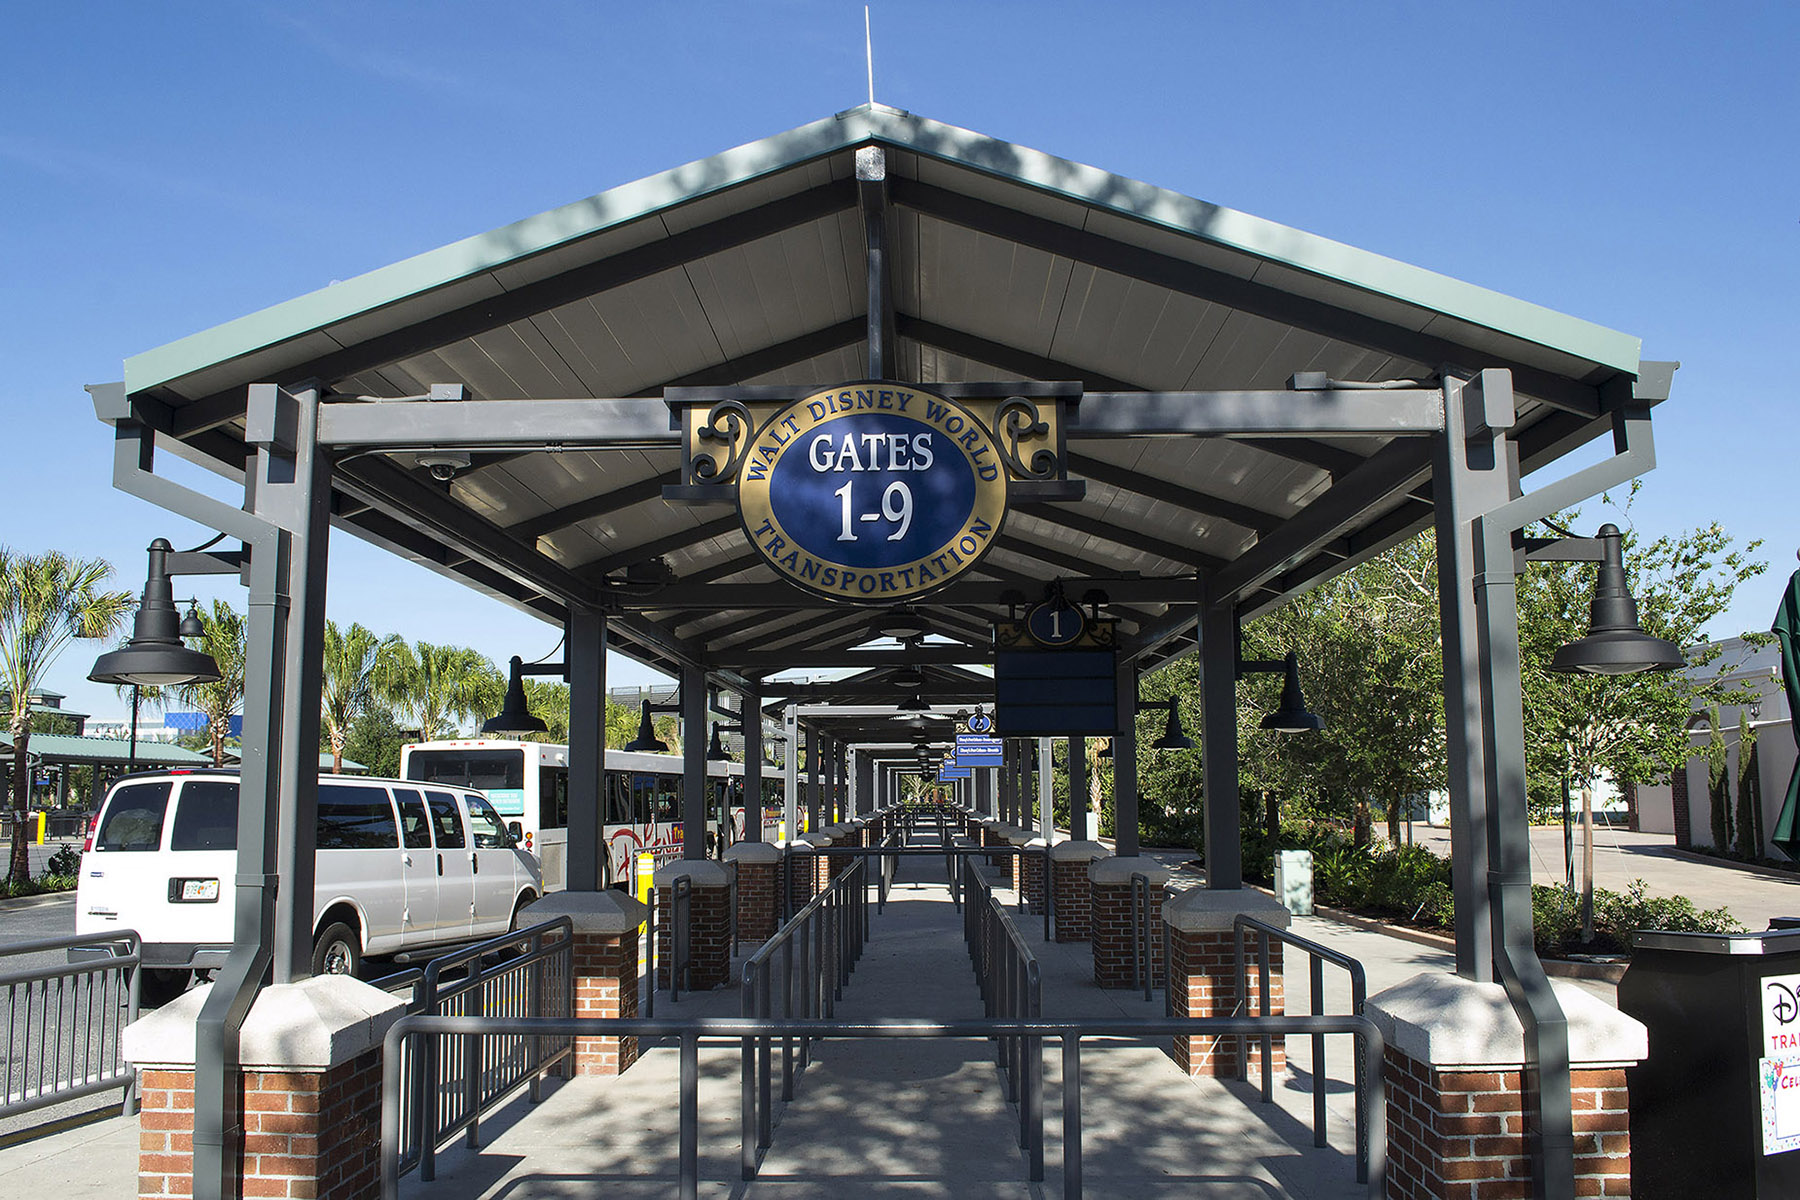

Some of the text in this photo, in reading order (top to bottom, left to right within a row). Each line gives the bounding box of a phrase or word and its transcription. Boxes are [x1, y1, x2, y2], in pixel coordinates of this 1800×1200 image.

[747, 389, 999, 482] WALT DISNEY WORLD
[808, 432, 934, 473] GATES
[834, 480, 914, 543] 1-9
[754, 516, 993, 594] TRANSPORTATION
[1048, 610, 1062, 638] 1
[1767, 982, 1800, 1026] D
[1771, 1032, 1800, 1050] TRA
[1781, 1075, 1800, 1089] CEL
